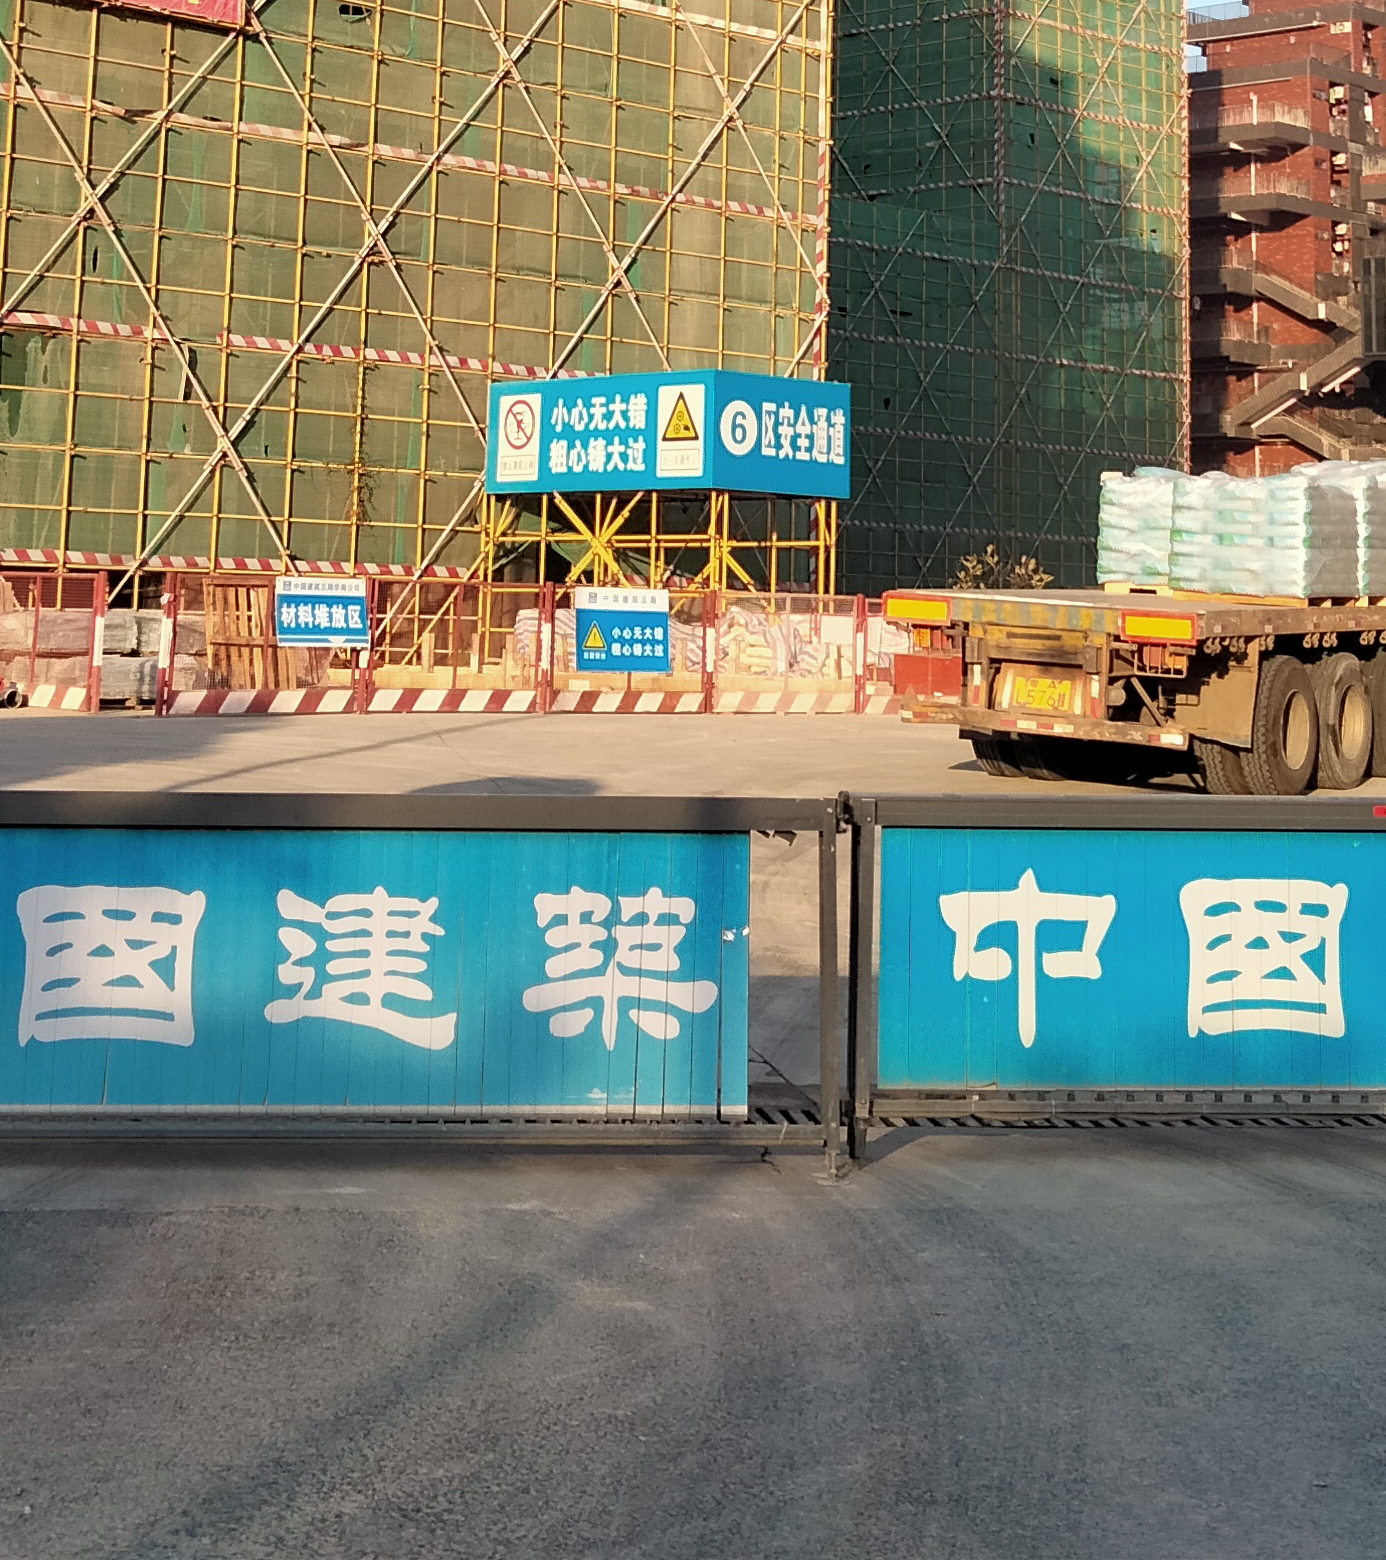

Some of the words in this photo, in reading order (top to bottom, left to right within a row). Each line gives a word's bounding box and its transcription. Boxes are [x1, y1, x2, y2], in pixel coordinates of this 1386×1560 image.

[550, 392, 648, 433] 小心无大错
[549, 434, 646, 474] 粗心铸大过
[281, 602, 363, 629] 材料堆放区
